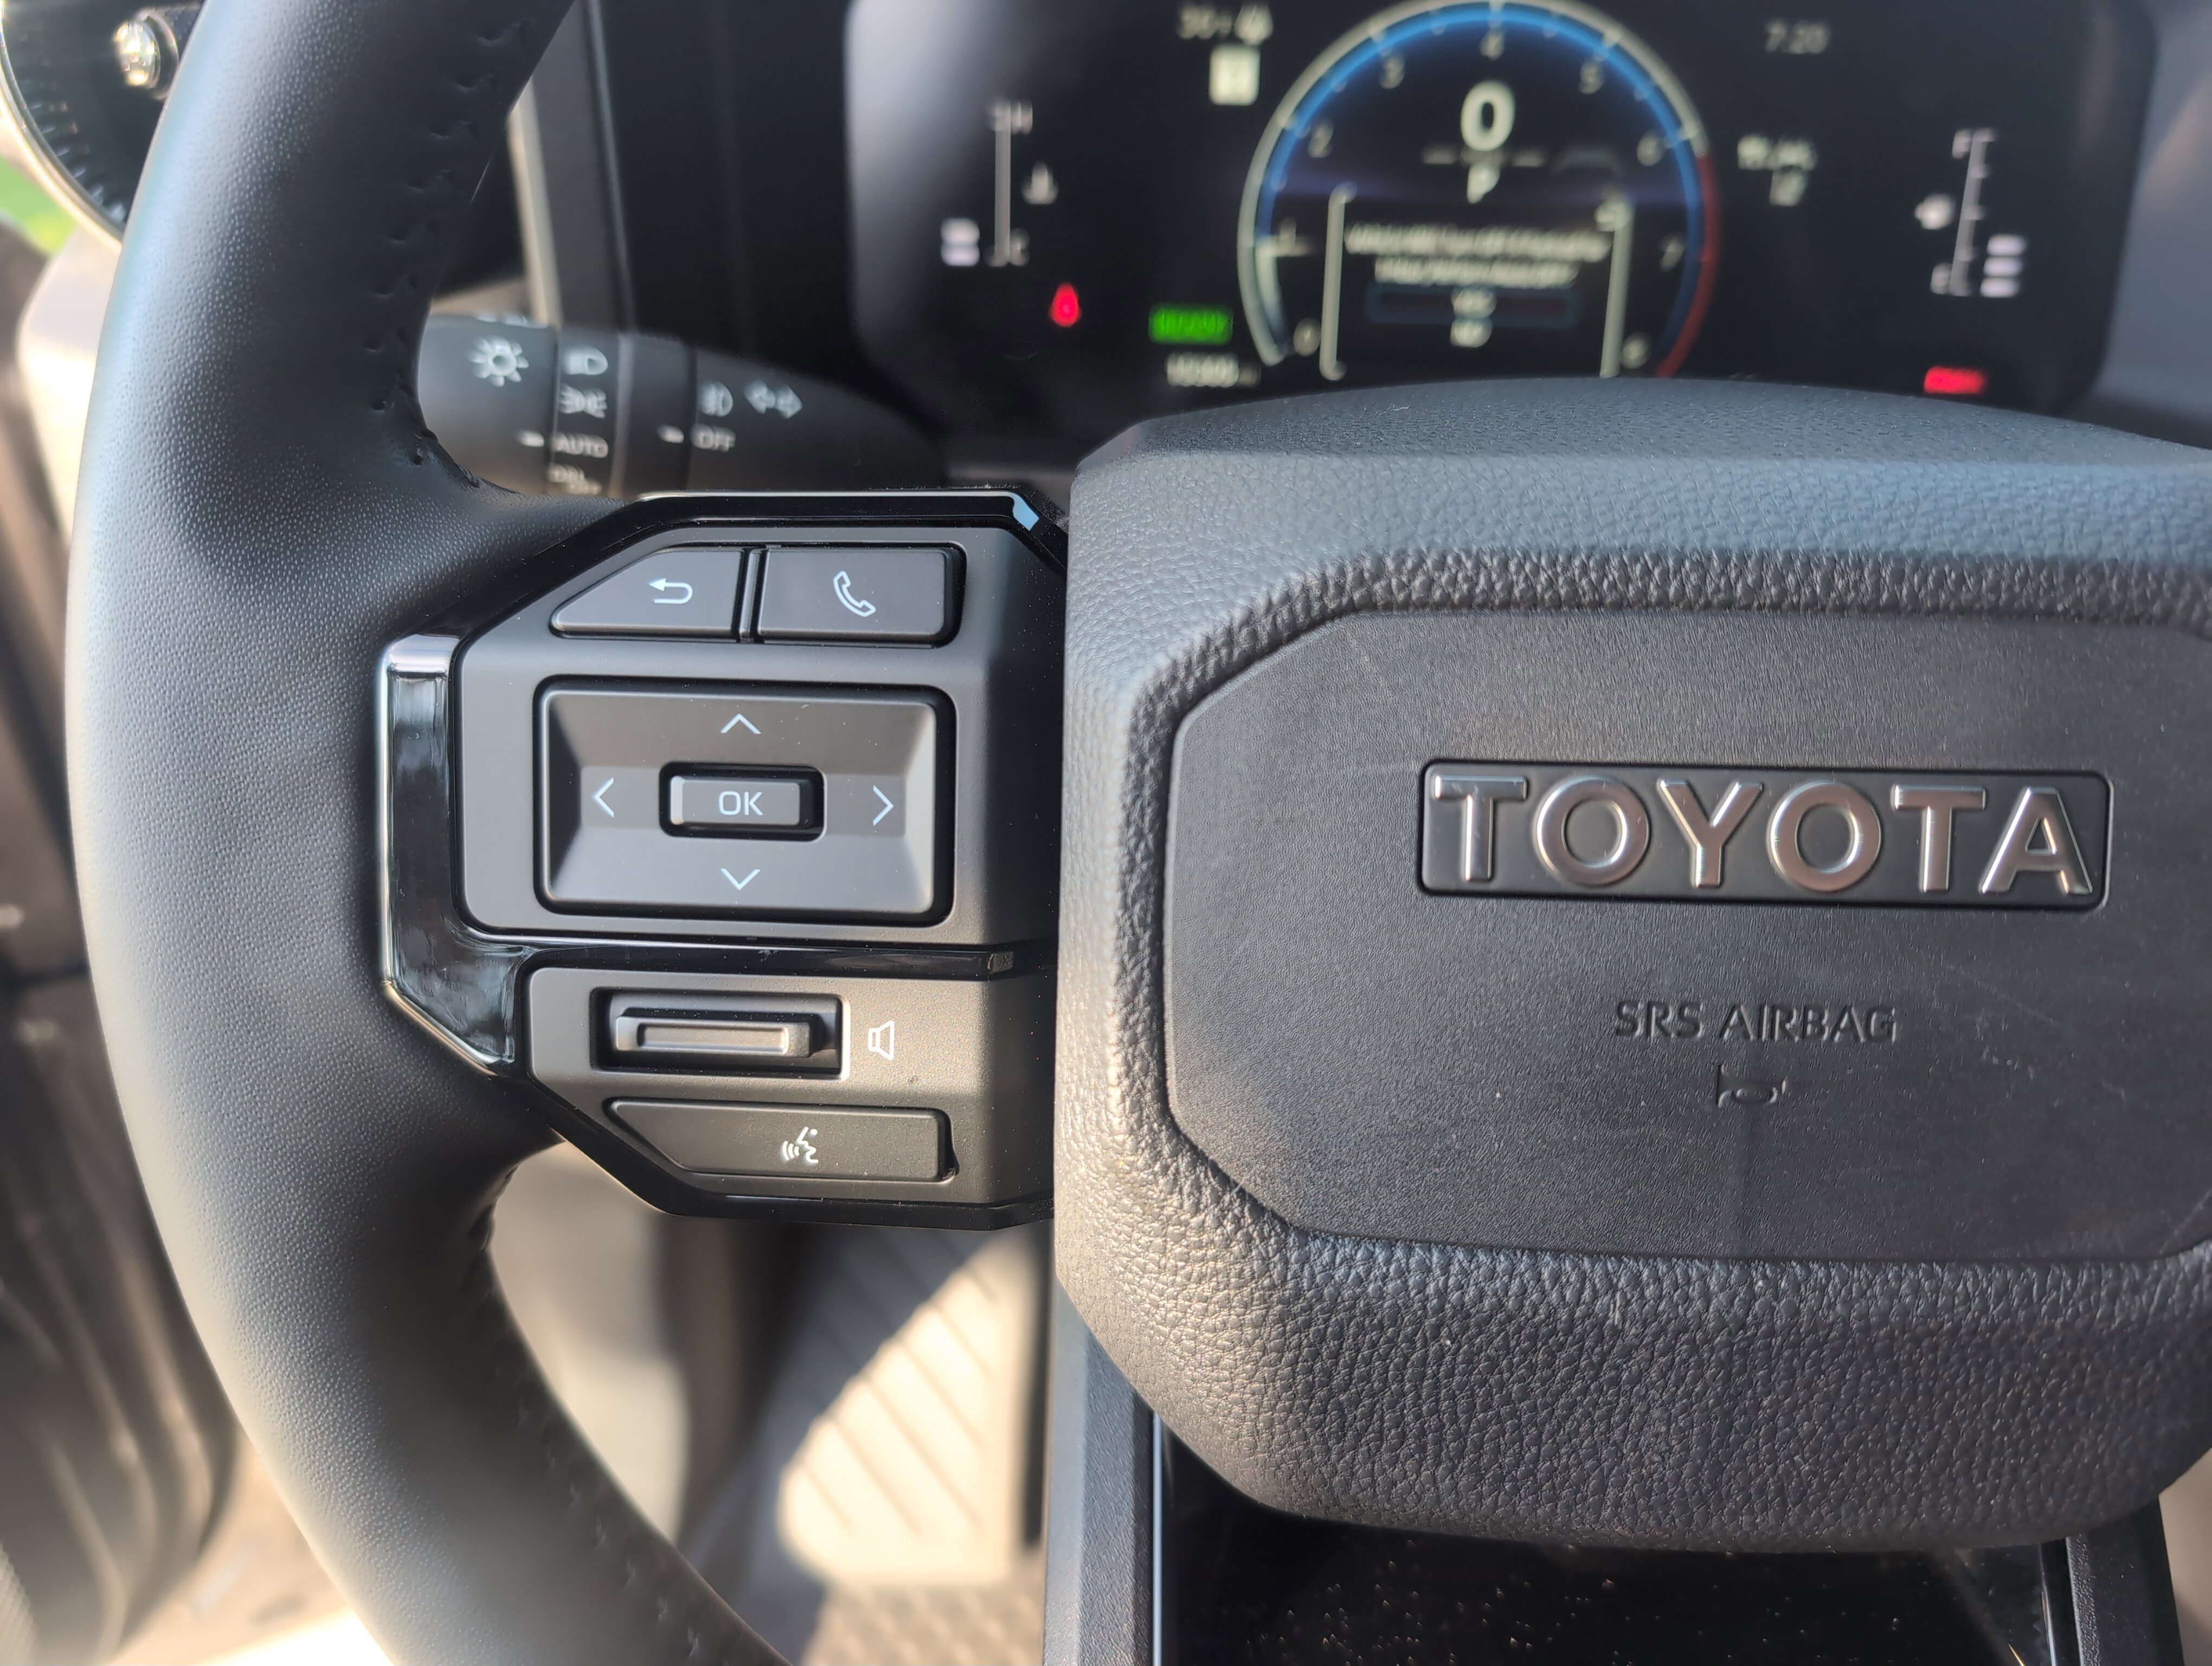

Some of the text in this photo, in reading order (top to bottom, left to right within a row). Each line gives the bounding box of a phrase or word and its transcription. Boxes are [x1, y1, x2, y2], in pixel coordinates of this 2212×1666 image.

[1461, 81, 1515, 151] 0
[552, 432, 608, 458] AUTO
[691, 423, 736, 452] OFF
[718, 791, 763, 816] OK
[1434, 774, 2093, 895] TOYOTA
[1616, 1001, 1896, 1043] SRS AIRBAG
